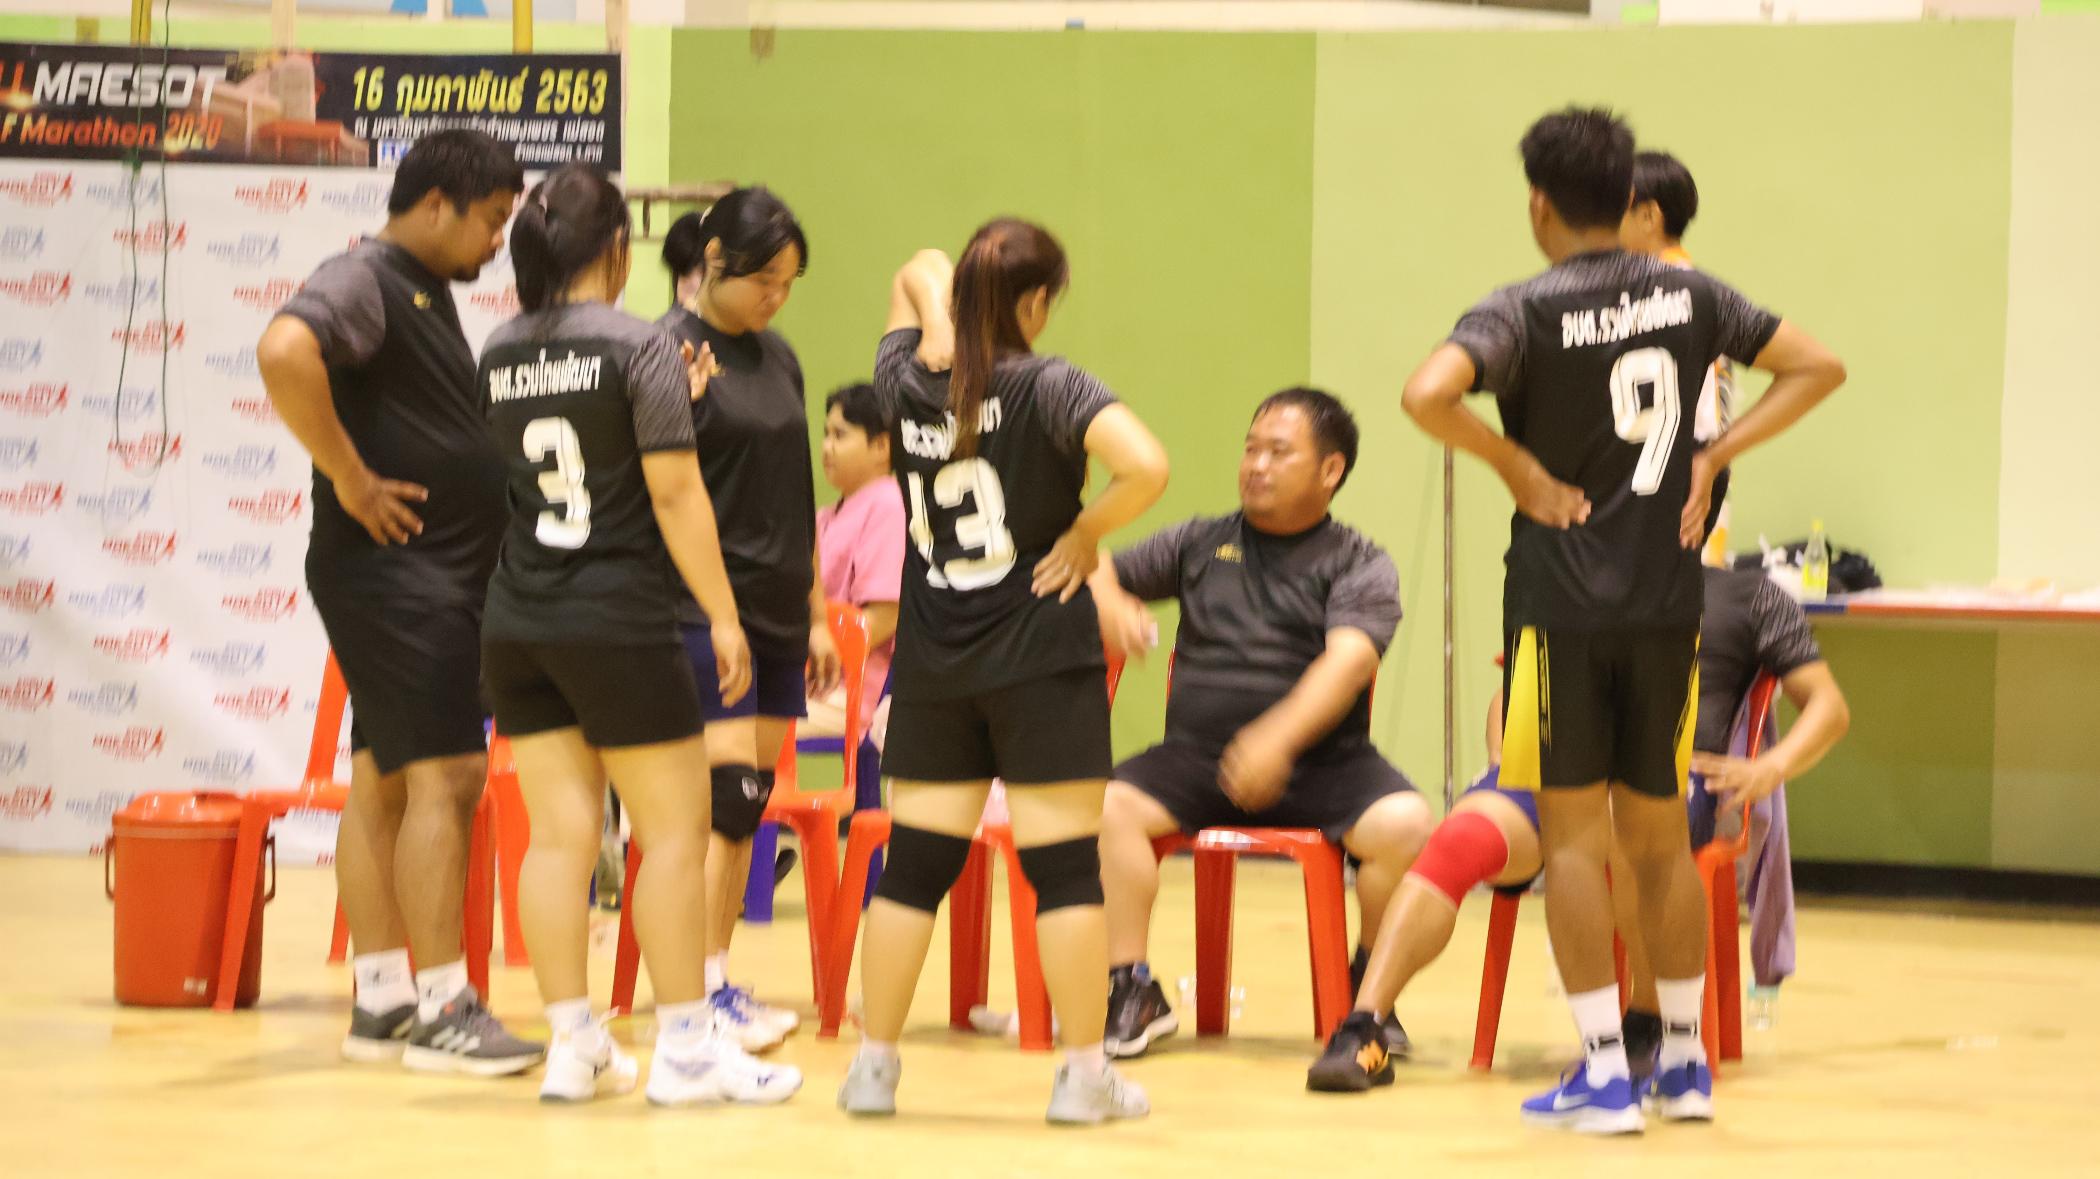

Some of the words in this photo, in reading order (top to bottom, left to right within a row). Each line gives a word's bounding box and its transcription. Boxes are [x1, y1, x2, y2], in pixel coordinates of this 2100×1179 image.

[20, 112, 157, 148] Marathon
[165, 110, 224, 150] 2020
[32, 60, 227, 113] MAESOT
[353, 66, 385, 112] 16
[396, 65, 530, 119] กุมภาพันธ์
[535, 68, 608, 115] 2563
[1609, 346, 1681, 496] 9
[522, 416, 591, 550] 3
[907, 456, 1018, 591] 13
